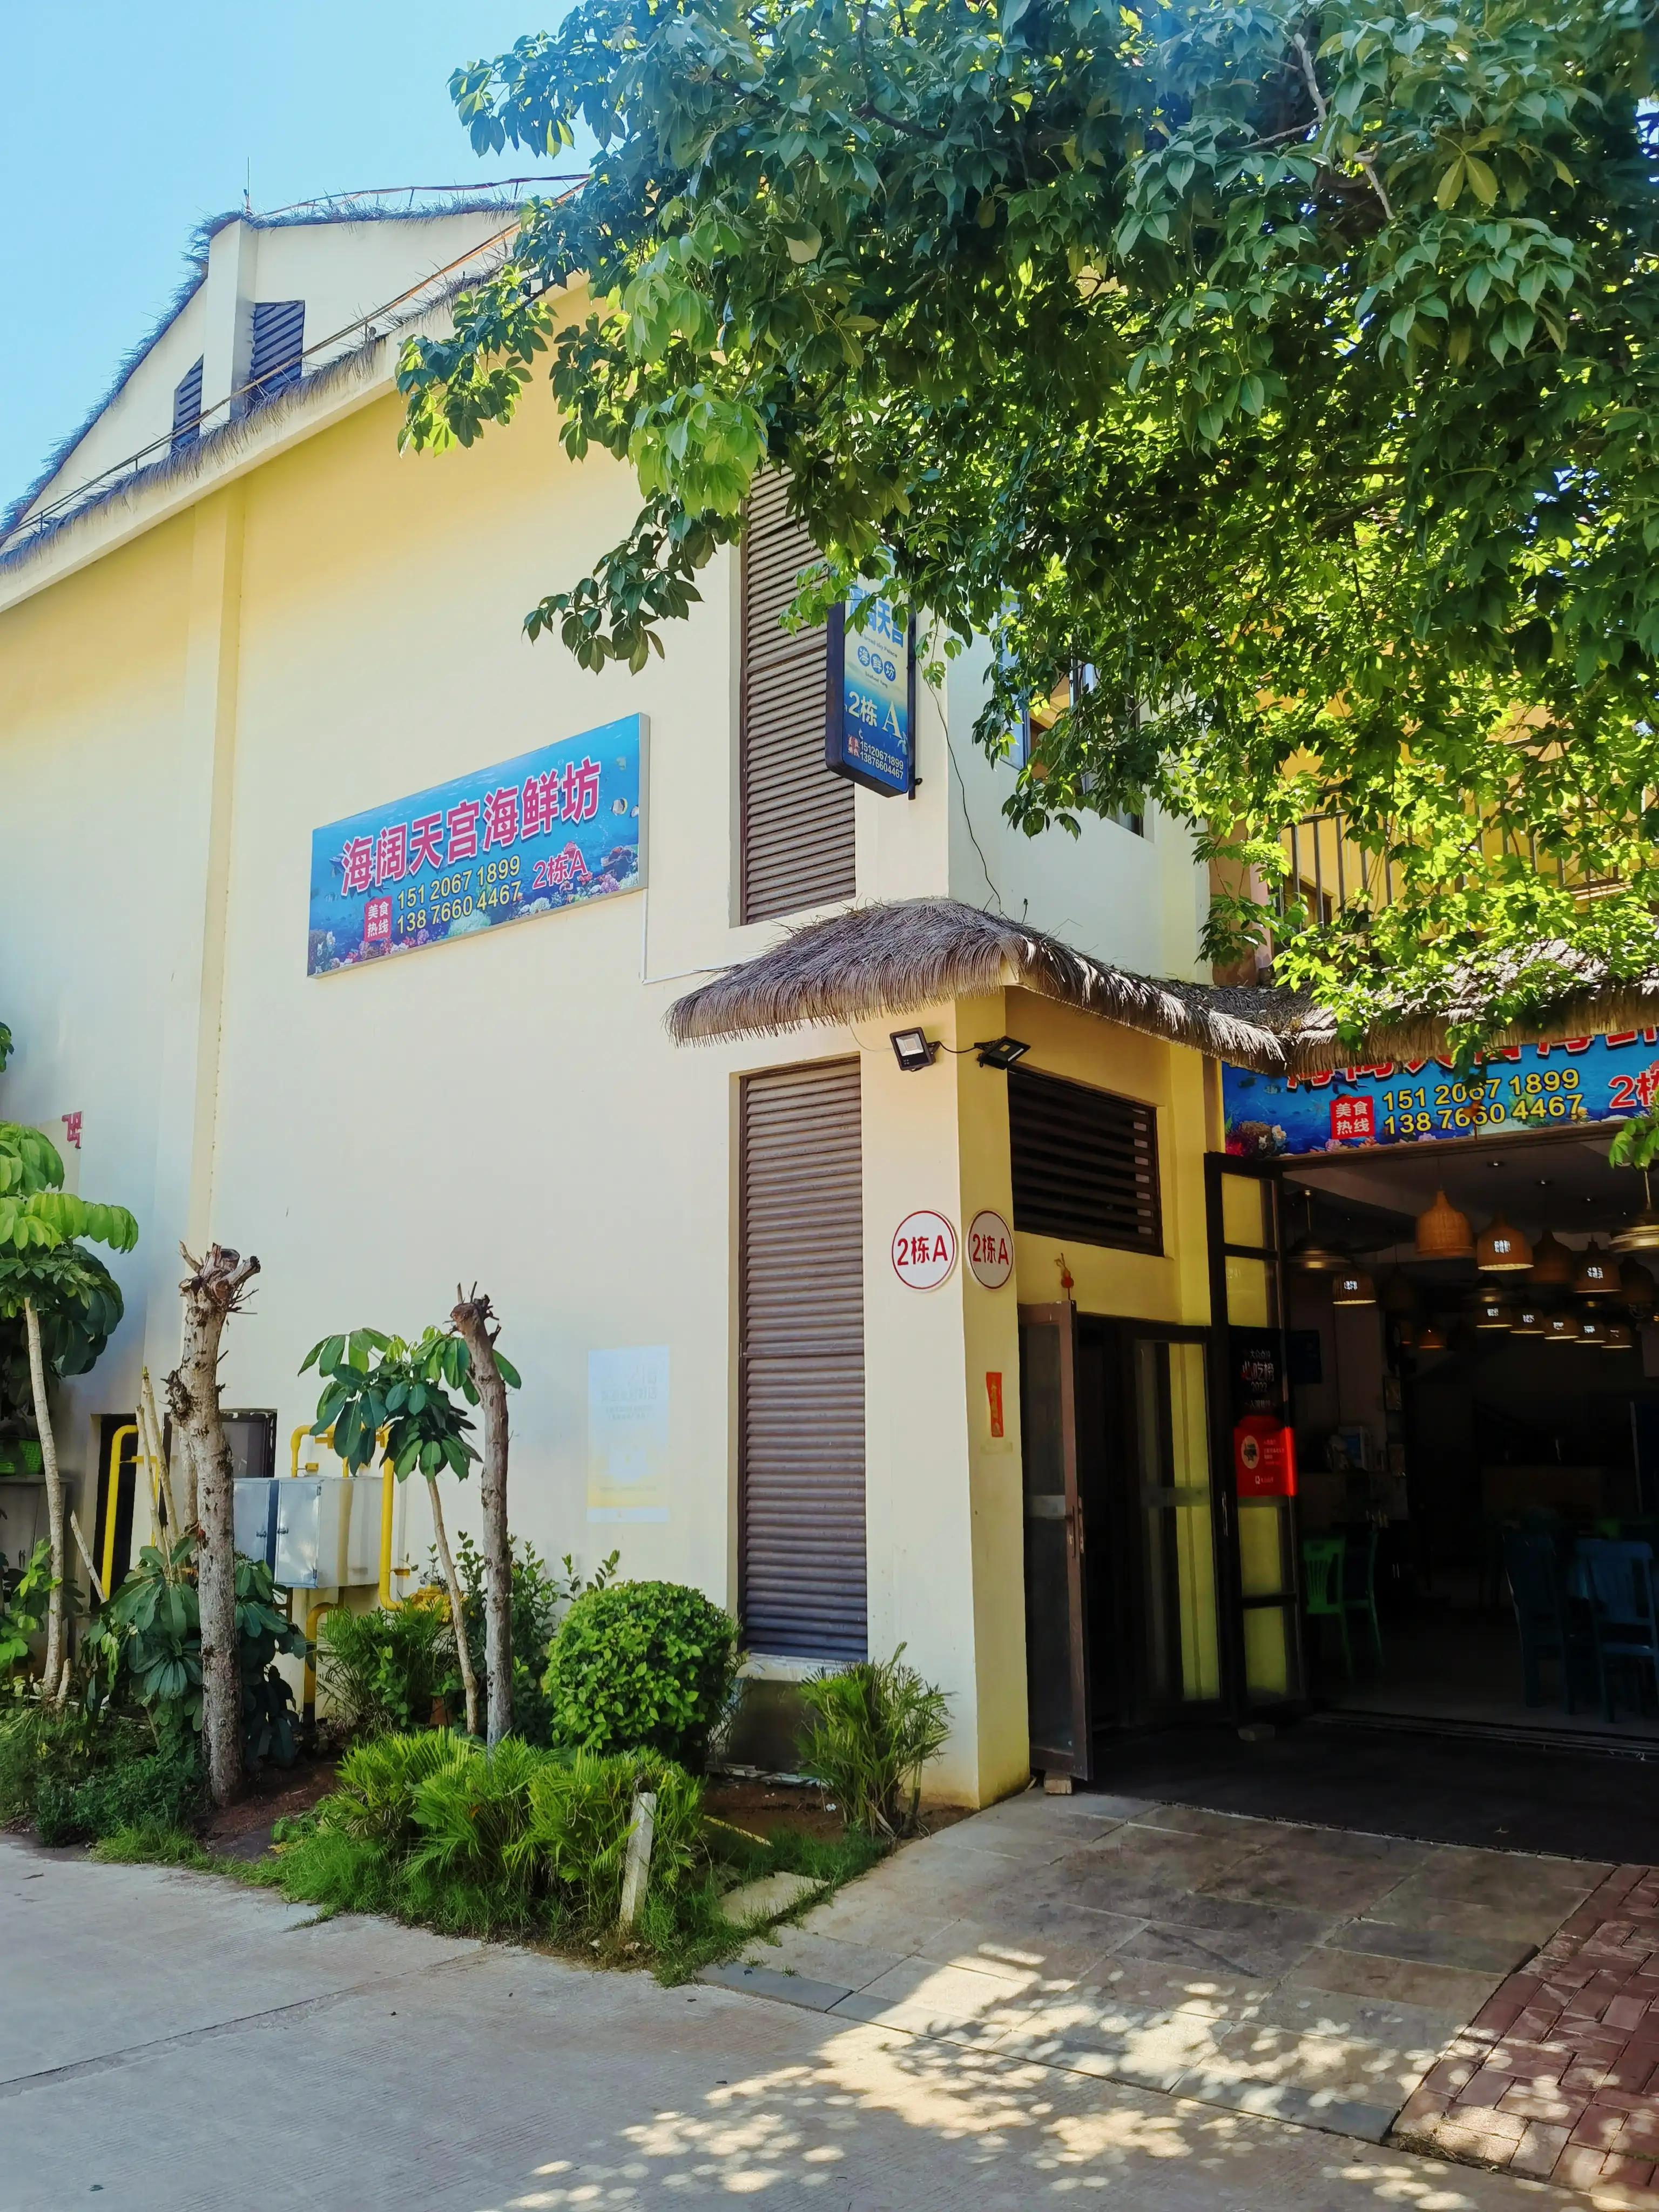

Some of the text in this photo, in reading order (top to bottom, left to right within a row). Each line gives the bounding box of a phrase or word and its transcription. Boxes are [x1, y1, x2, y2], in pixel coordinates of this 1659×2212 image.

[859, 646, 895, 680] 海鲜坊
[860, 740, 903, 770] 15120671899
[860, 751, 903, 780] 13876604467
[340, 756, 601, 896] 海阔天宫海鲜坊
[397, 855, 521, 910] 151 2067 1899
[532, 849, 588, 891] 2栋A
[368, 900, 389, 921] 美食
[397, 881, 522, 934] 138 7660 4467
[367, 918, 389, 938] 热线
[1383, 1088, 1426, 1111] 151
[1509, 1068, 1579, 1096] 1899
[1336, 1101, 1368, 1118] 美食
[1384, 1111, 1432, 1135] 138
[1512, 1093, 1583, 1119] 4467
[1336, 1118, 1370, 1136] 热线
[897, 1235, 949, 1266] 2栋A
[972, 1233, 1009, 1266] 2栋A
